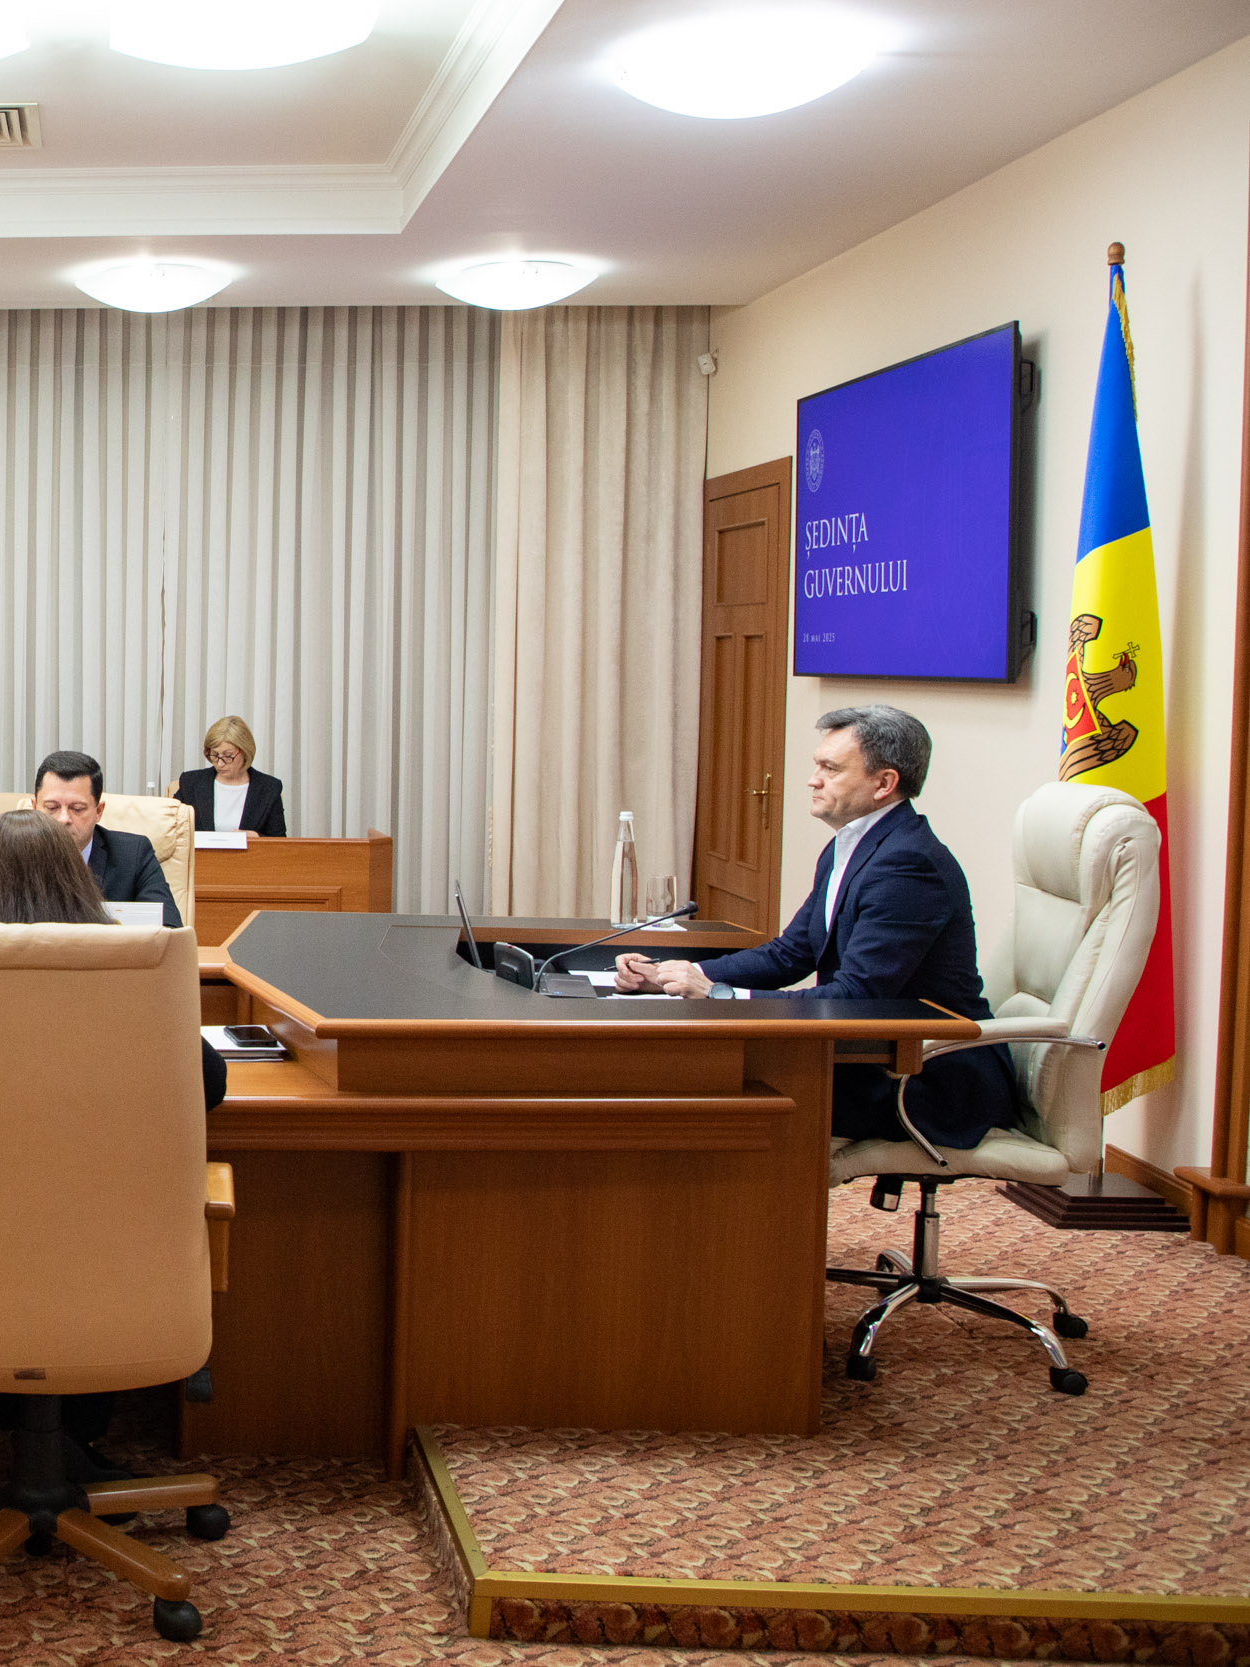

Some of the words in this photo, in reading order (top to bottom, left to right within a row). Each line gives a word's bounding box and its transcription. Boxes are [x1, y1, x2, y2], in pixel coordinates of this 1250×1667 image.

[805, 512, 869, 560] ȘEDINȚA
[804, 559, 908, 599] GUVERNULUI
[822, 632, 835, 642] 2025
